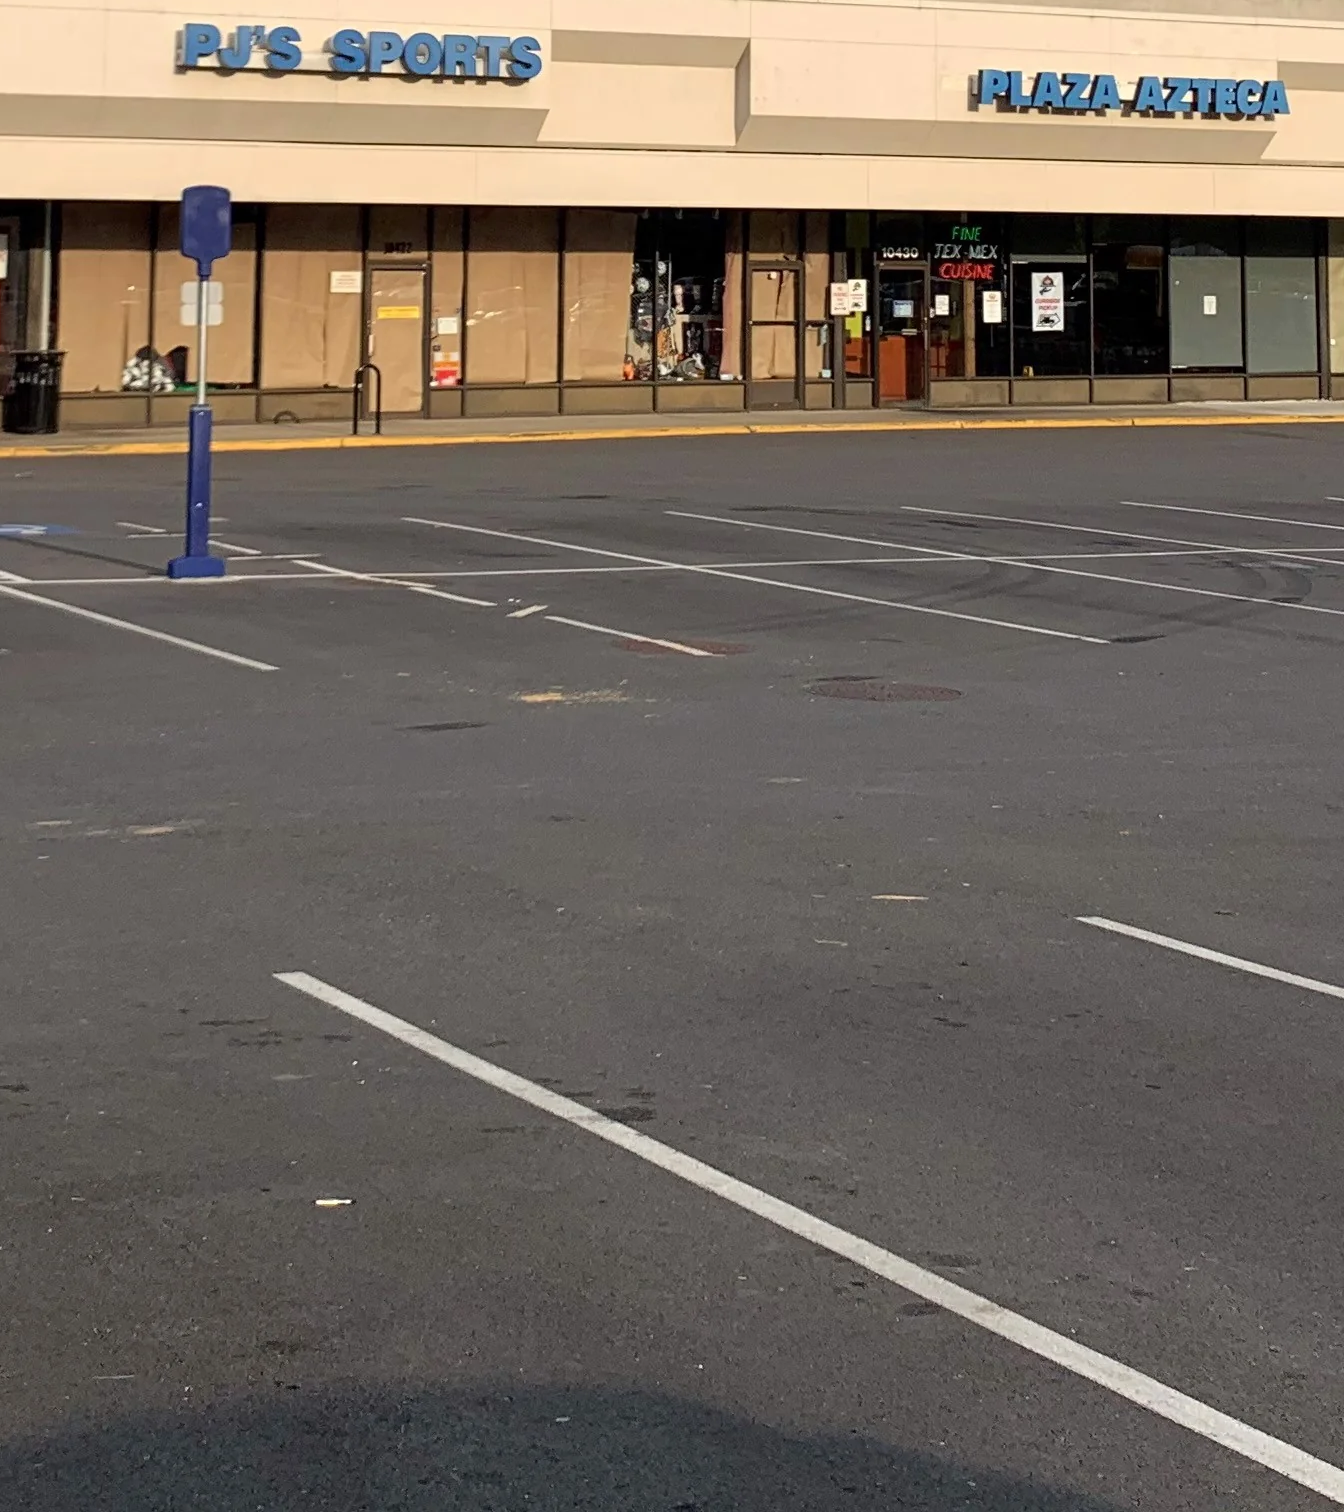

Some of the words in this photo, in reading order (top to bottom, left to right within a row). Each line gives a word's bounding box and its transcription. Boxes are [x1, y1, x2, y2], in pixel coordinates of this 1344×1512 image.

[180, 22, 302, 72] PJ'S
[327, 28, 542, 80] SPORTS
[976, 68, 1121, 110] PLAZA
[1134, 75, 1291, 115] AZTECA
[951, 226, 982, 242] FINE
[882, 247, 919, 258] 10430
[939, 263, 995, 280] CUISINE
